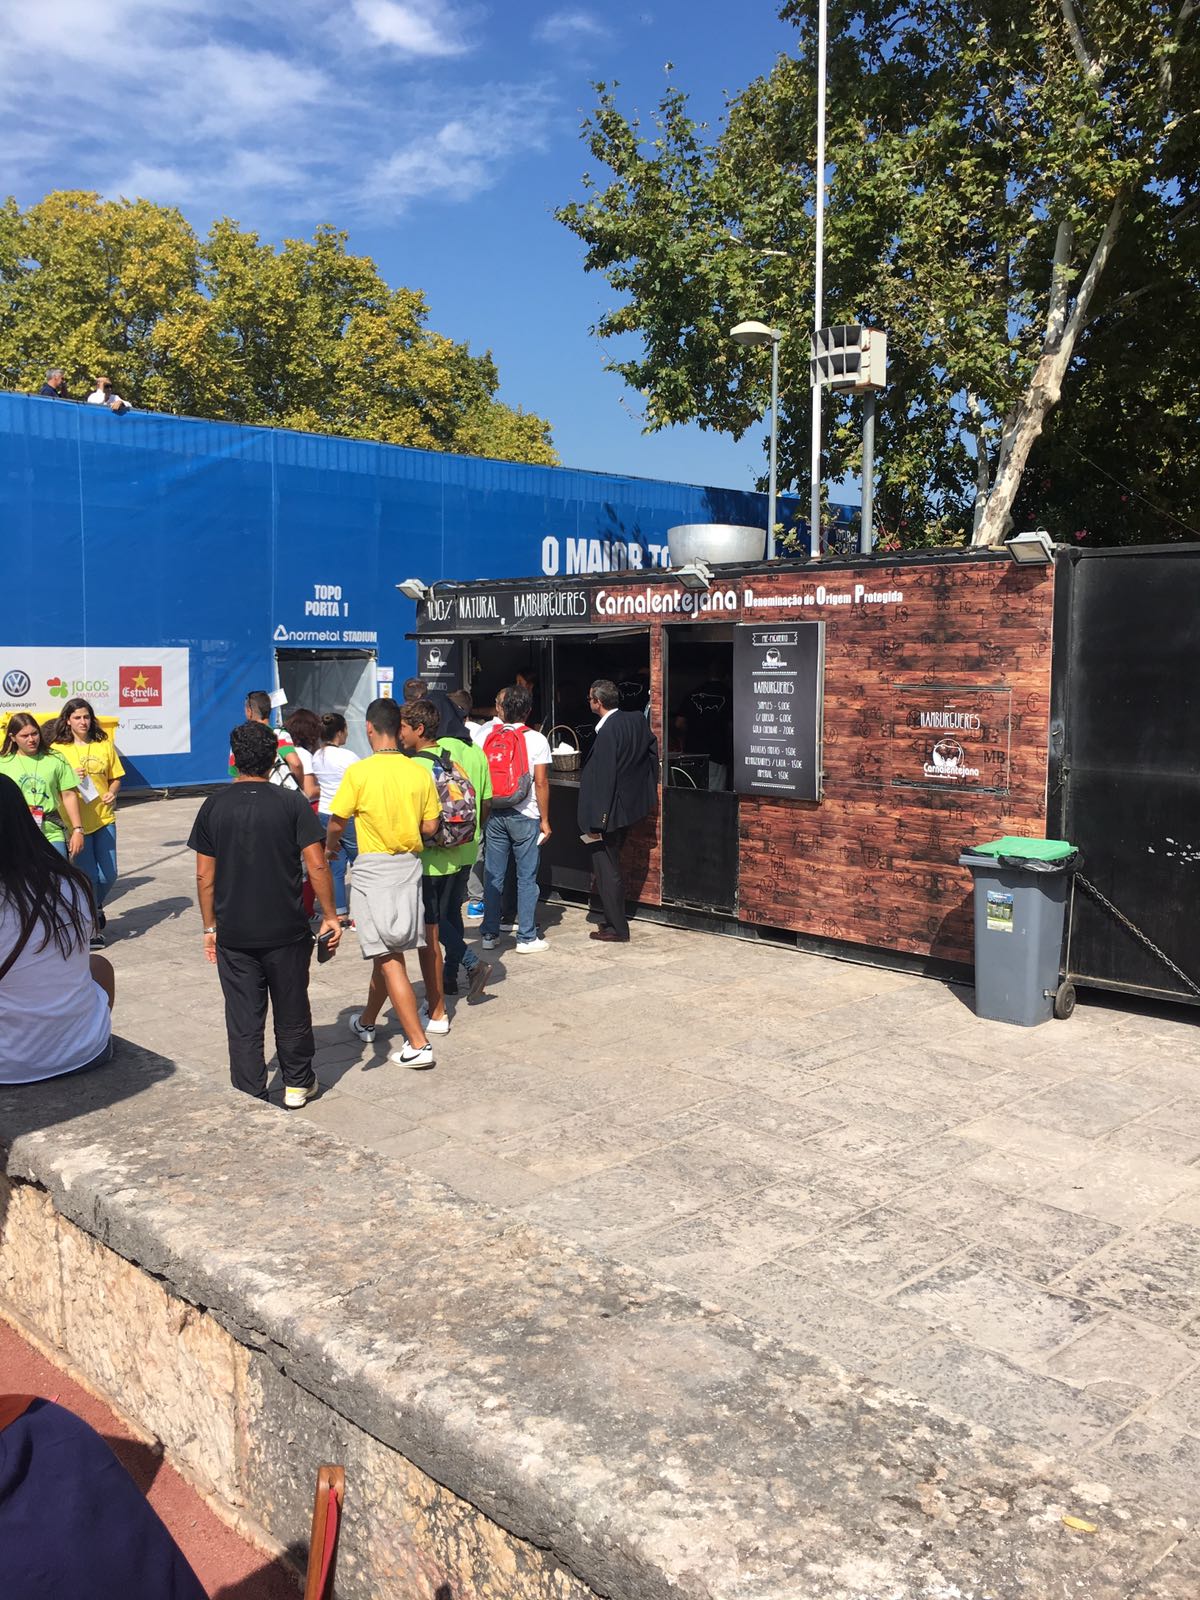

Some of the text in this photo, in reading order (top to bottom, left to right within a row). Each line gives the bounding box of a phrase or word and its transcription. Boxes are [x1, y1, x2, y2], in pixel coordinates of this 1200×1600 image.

[542, 536, 559, 576] O
[566, 537, 643, 575] MAIOR
[314, 585, 342, 600] TOPO
[744, 585, 903, 608] Denominação de Origem Protegida
[305, 601, 349, 617] PORTA 1
[427, 596, 452, 621] 100%
[459, 596, 500, 618] NATURAL
[595, 588, 737, 619] Carnalentejana
[289, 631, 377, 642] normetal STADIUM
[72, 680, 109, 696] JOGOS
[122, 687, 159, 698] Estrella
[132, 722, 163, 730] JCDecaux
[920, 711, 980, 730] HAMBURGUERES
[923, 763, 980, 778] Carnalentejana
